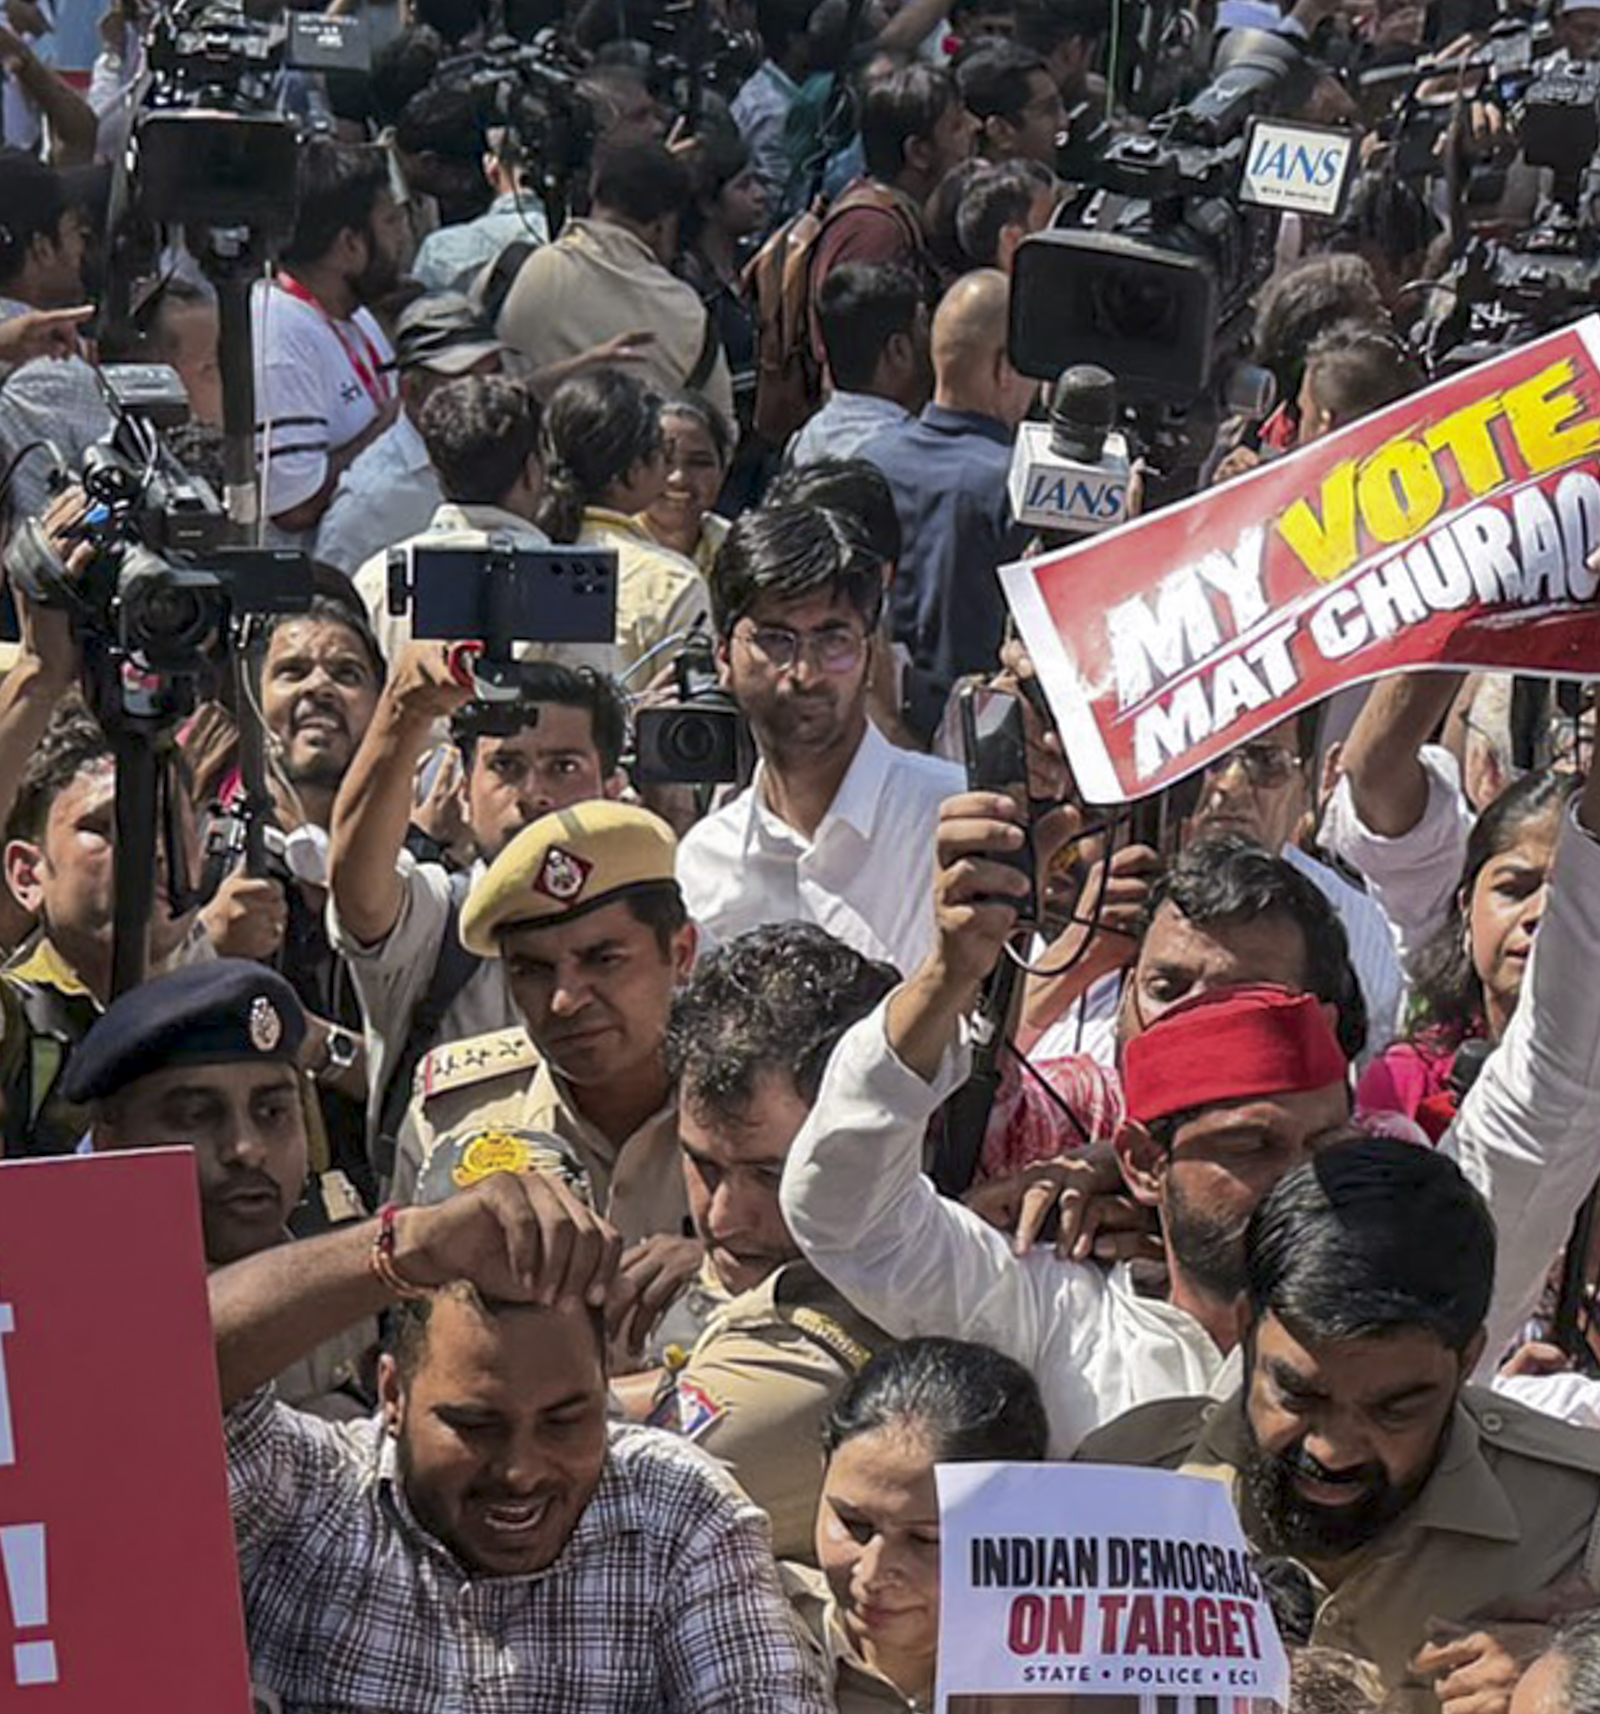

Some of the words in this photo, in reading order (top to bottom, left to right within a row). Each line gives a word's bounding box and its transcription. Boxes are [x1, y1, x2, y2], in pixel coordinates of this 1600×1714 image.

[1251, 139, 1342, 187] IANS
[1027, 476, 1126, 518] IANS
[1106, 525, 1270, 714] MY
[1133, 617, 1300, 783] MAT
[971, 1537, 1099, 1588] INDIAN
[1107, 1537, 1260, 1600] DEMOCRAC
[1008, 1593, 1086, 1656] ON
[1098, 1594, 1261, 1660] TARGET
[1023, 1665, 1092, 1682] STATE
[1123, 1667, 1203, 1684] POLICE
[1228, 1669, 1258, 1686] ECI
